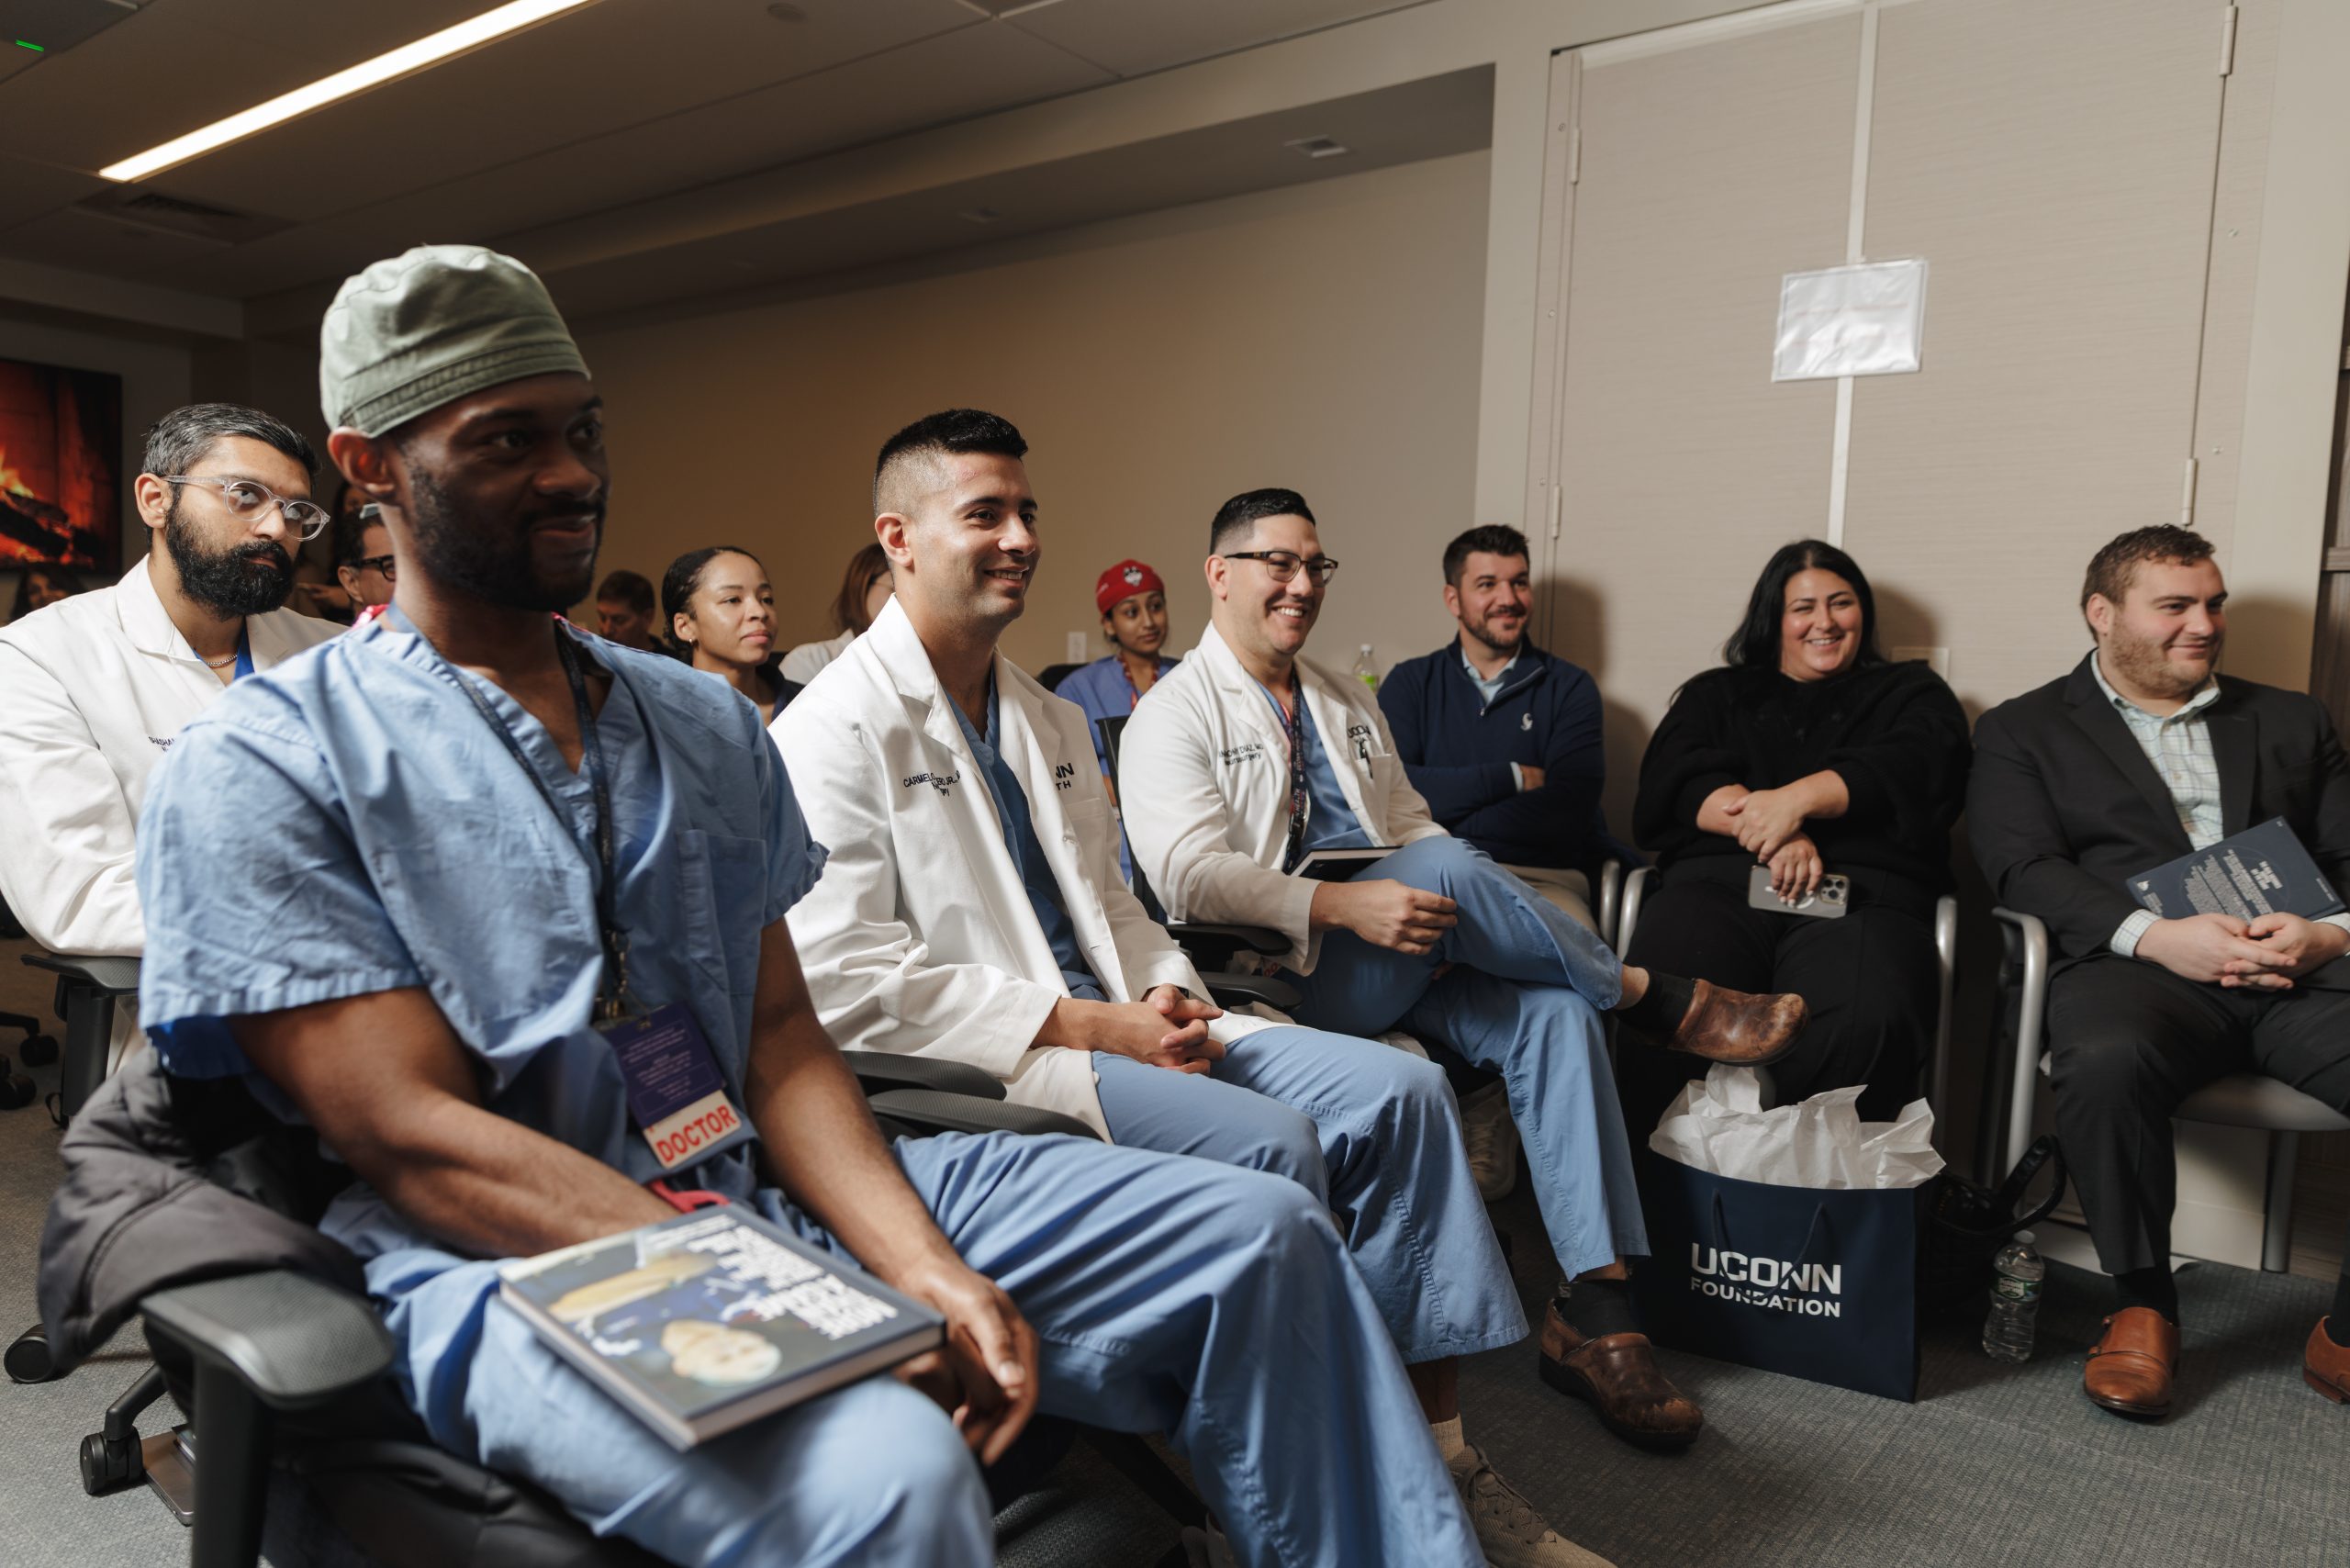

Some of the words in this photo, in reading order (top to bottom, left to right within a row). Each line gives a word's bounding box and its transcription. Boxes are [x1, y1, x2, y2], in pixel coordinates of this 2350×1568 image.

[655, 1104, 736, 1163] DOCTOR
[1691, 1242, 1842, 1294] UCONN
[1690, 1276, 1841, 1318] FOUNDATION
